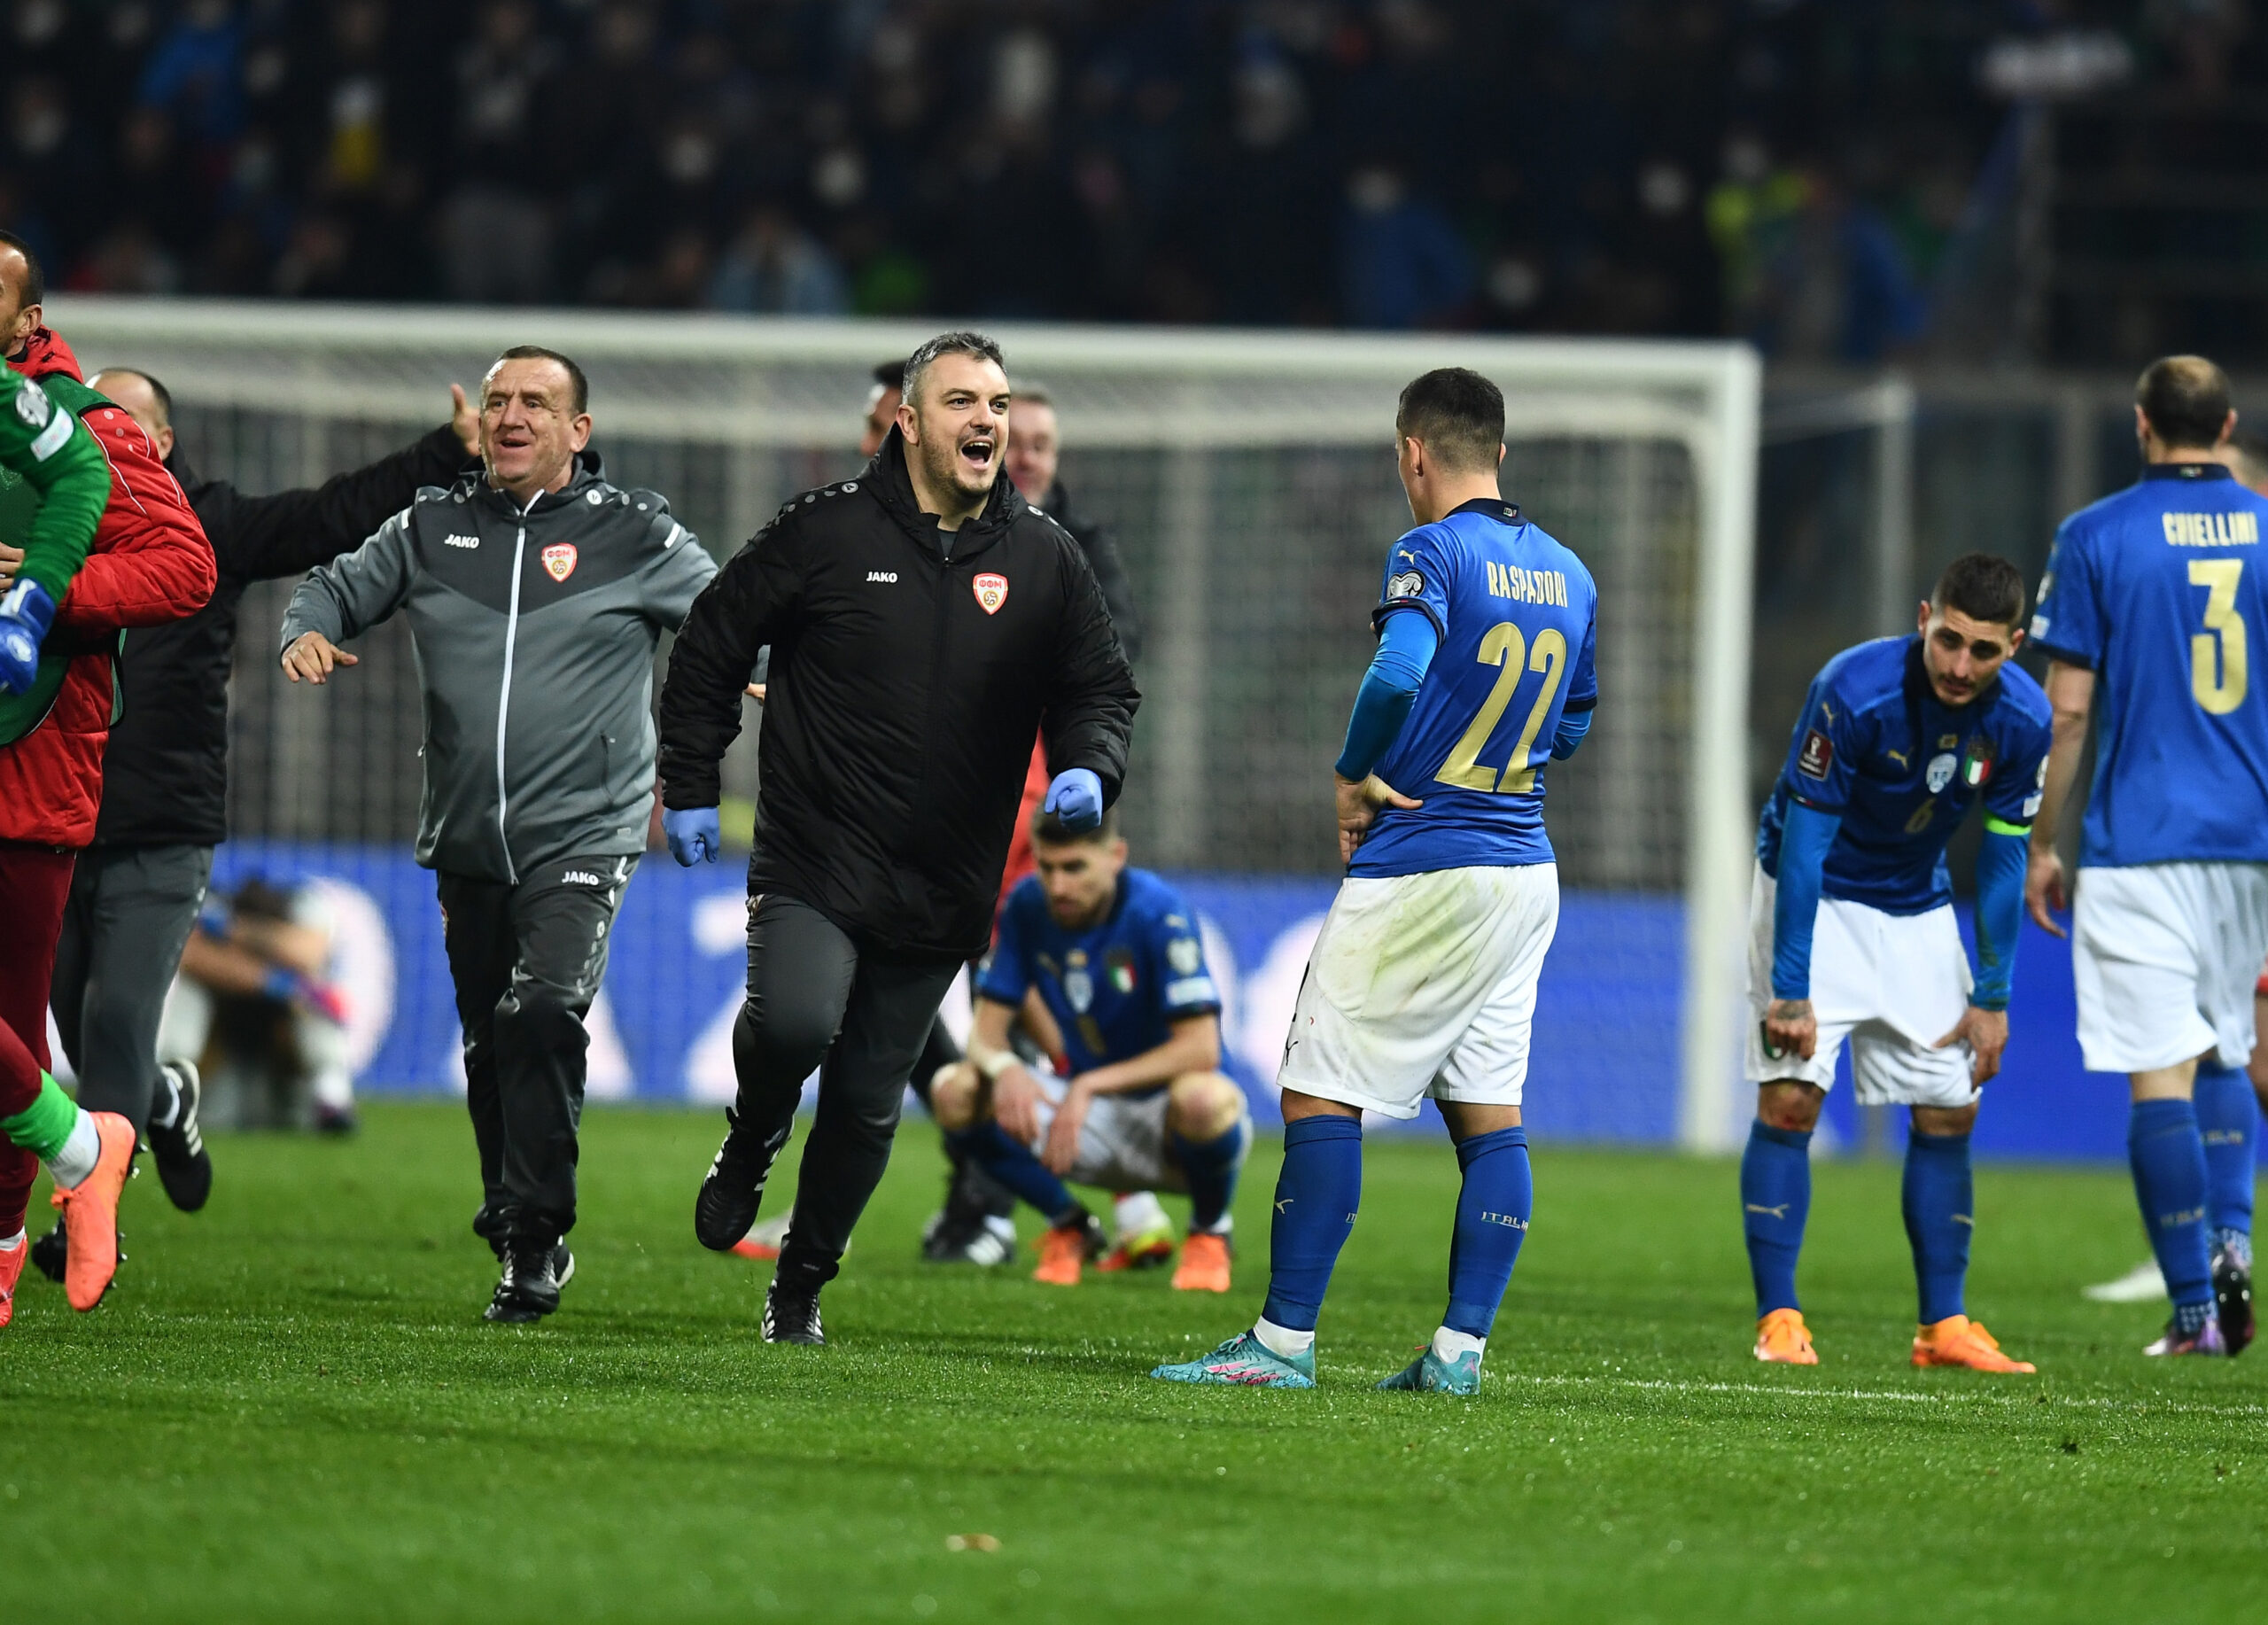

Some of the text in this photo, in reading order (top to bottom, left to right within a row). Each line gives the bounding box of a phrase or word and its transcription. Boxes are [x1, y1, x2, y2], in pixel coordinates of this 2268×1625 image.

[444, 533, 480, 549] JAKO
[2163, 511, 2258, 547] CHIELLINI
[866, 571, 898, 583] JAKO
[1486, 561, 1568, 608] RASPADORI
[2187, 558, 2248, 715] 3
[1433, 621, 1567, 793] 22
[561, 870, 599, 886] JAKO
[1481, 1211, 1529, 1230] ITALIA
